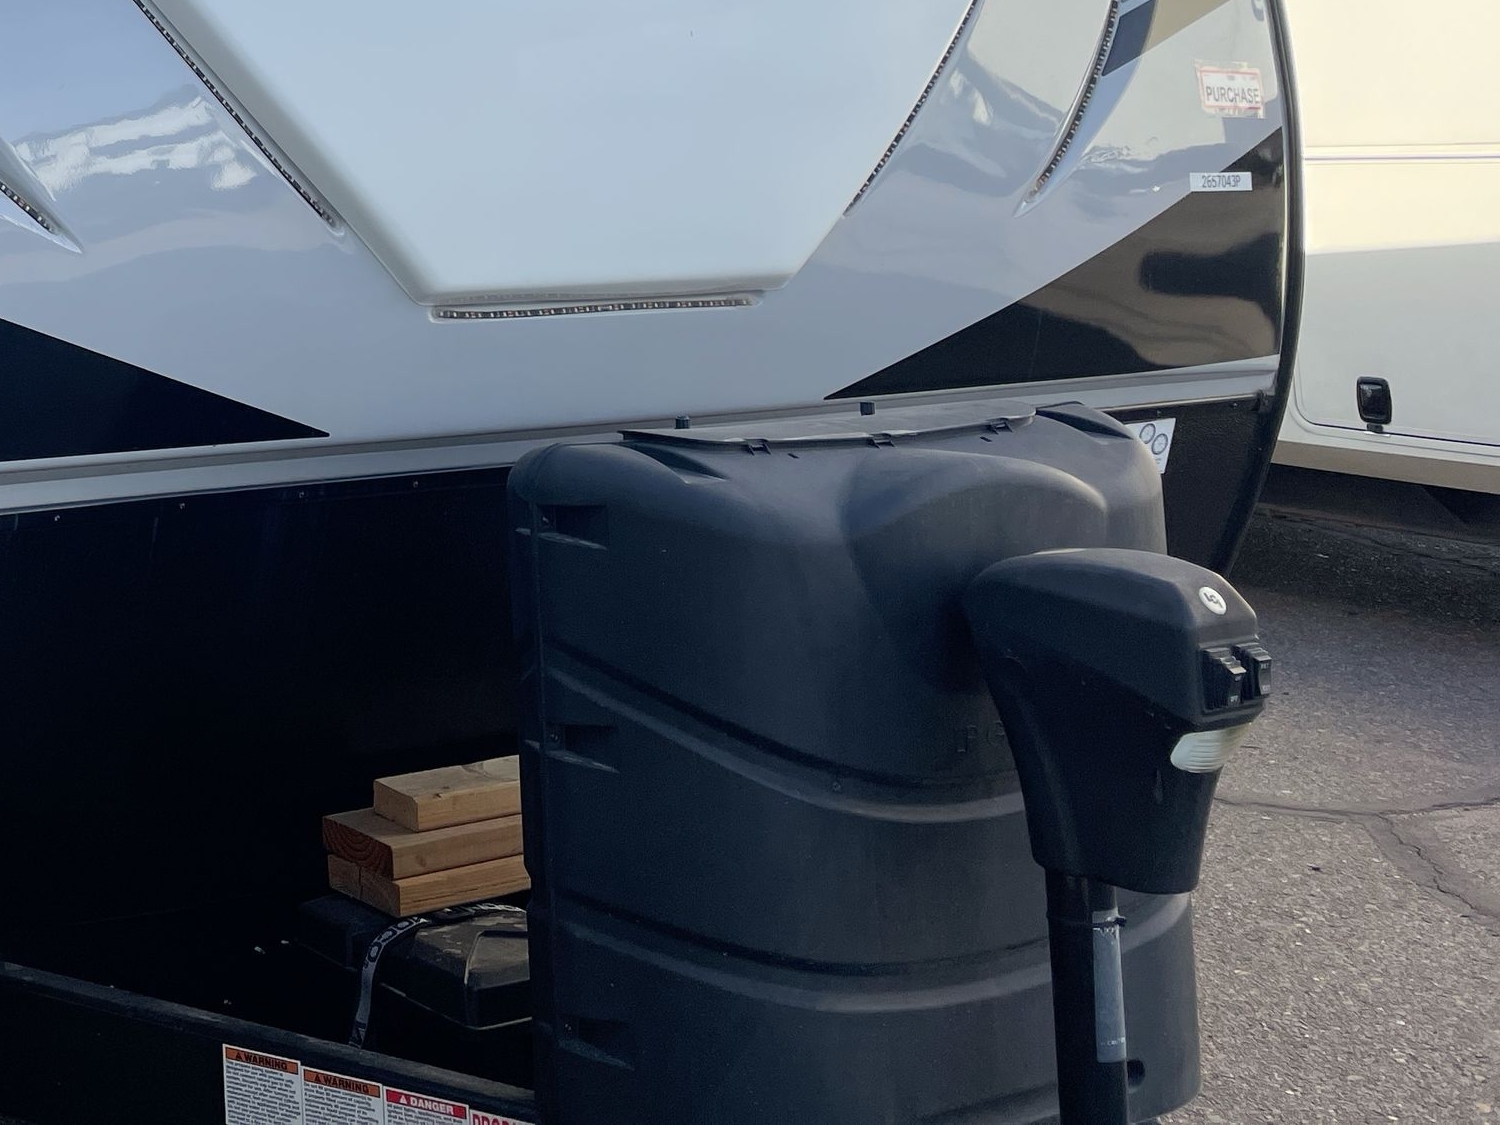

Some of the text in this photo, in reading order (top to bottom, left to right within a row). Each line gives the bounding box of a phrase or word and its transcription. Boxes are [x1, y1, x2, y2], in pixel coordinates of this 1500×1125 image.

[1205, 85, 1260, 104] PURCHASE
[245, 1053, 288, 1071] WARNING
[323, 1075, 370, 1094] WARNING
[410, 1096, 455, 1115] DANGER
